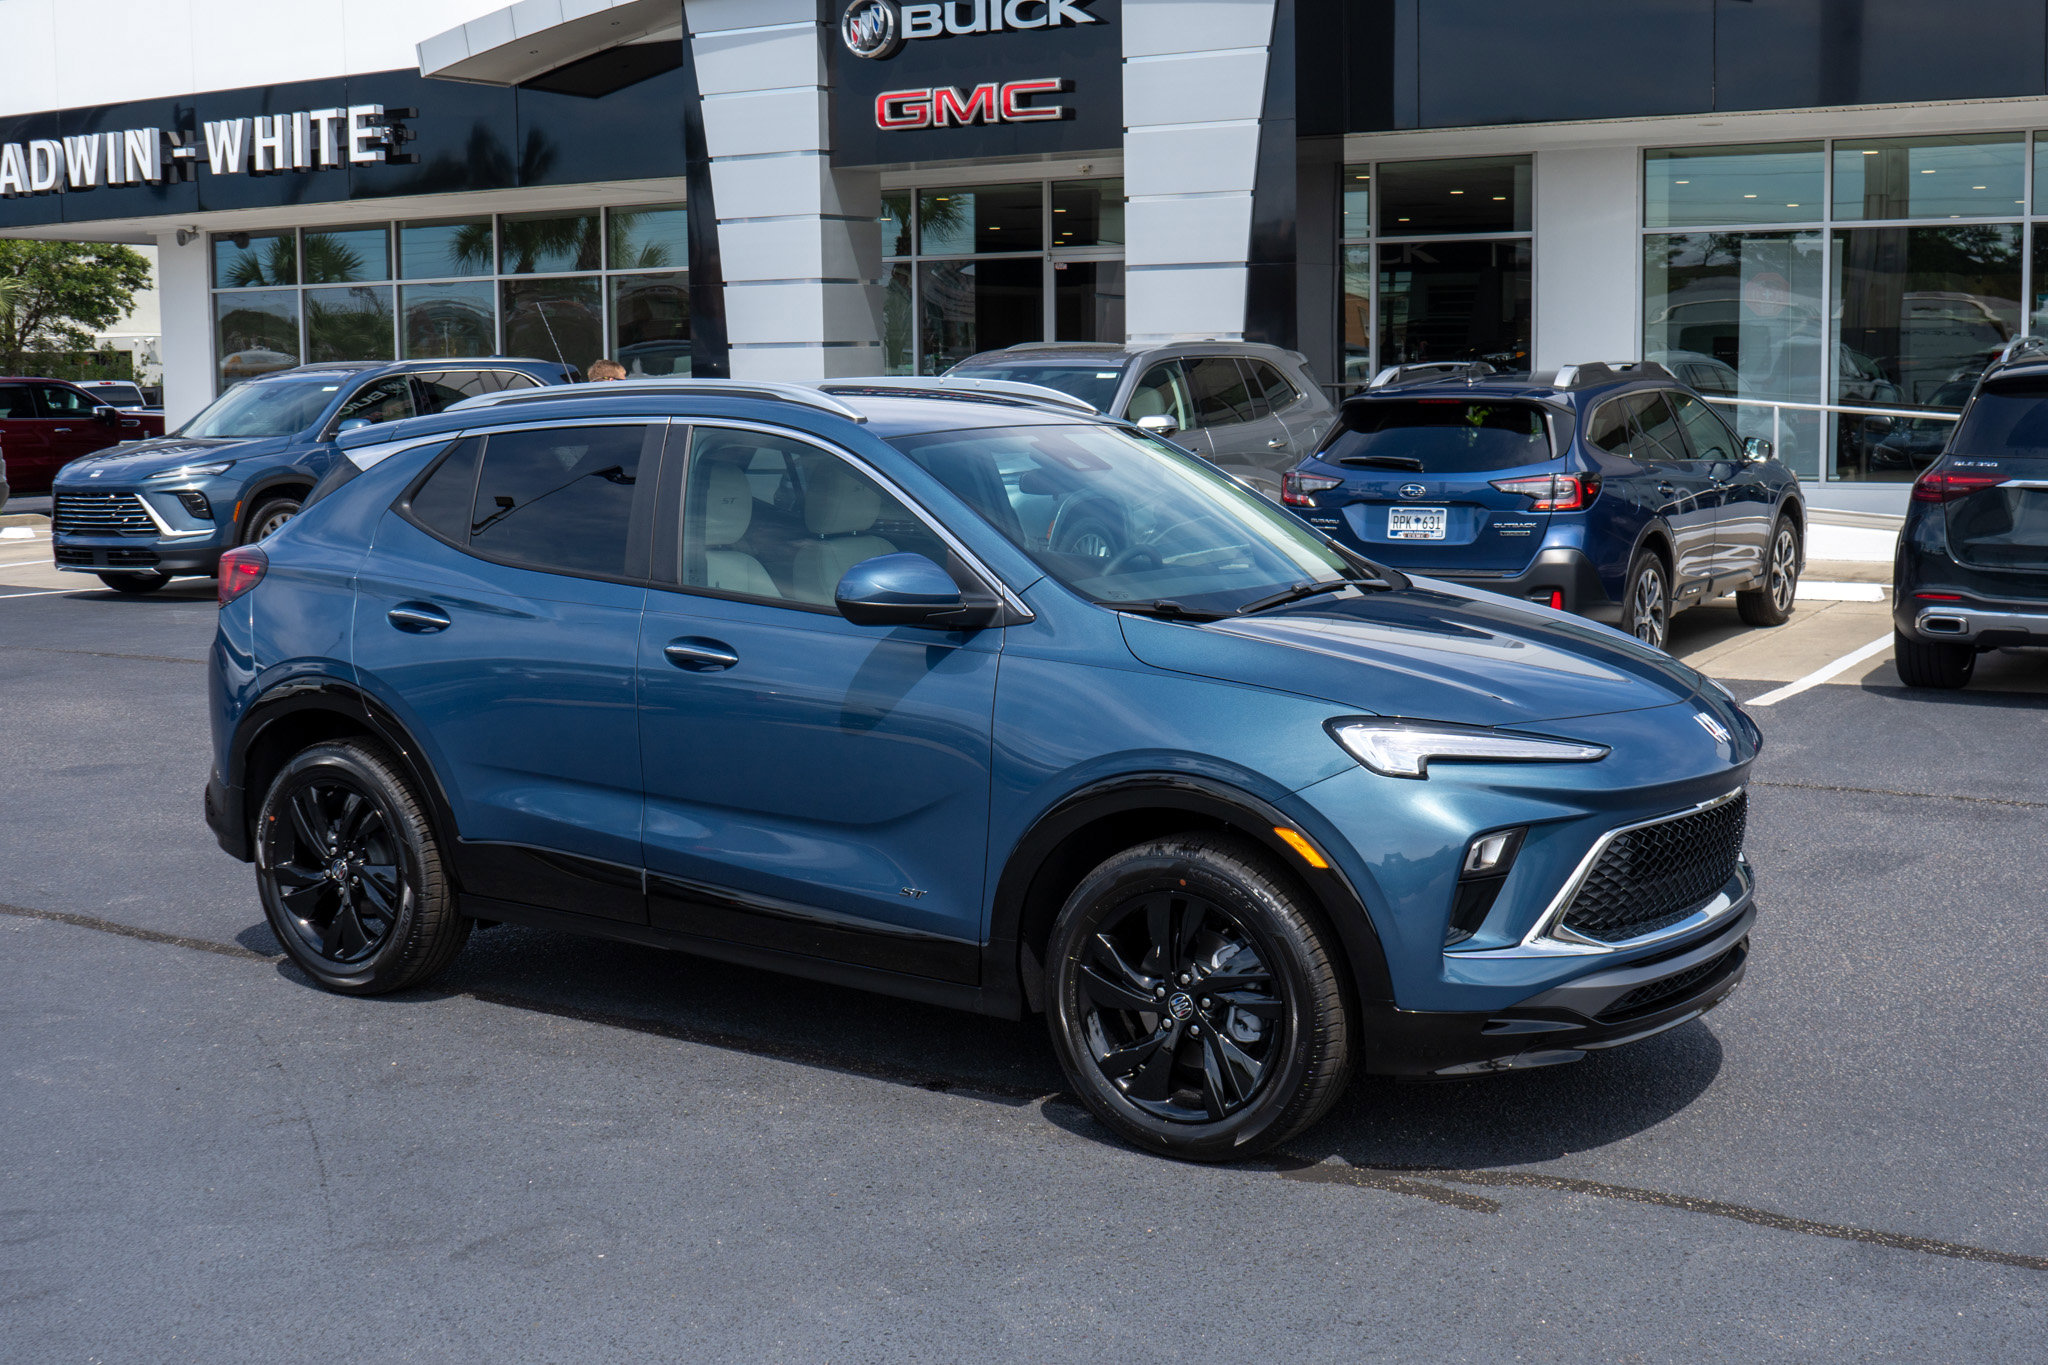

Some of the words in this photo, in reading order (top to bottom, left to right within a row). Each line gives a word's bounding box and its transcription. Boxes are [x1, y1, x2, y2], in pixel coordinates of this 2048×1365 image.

[901, 0, 1096, 40] BUICK
[875, 77, 1062, 131] GMC
[1393, 515, 1412, 529] RPK
[1422, 516, 1441, 530] 631
[901, 886, 928, 899] ST
